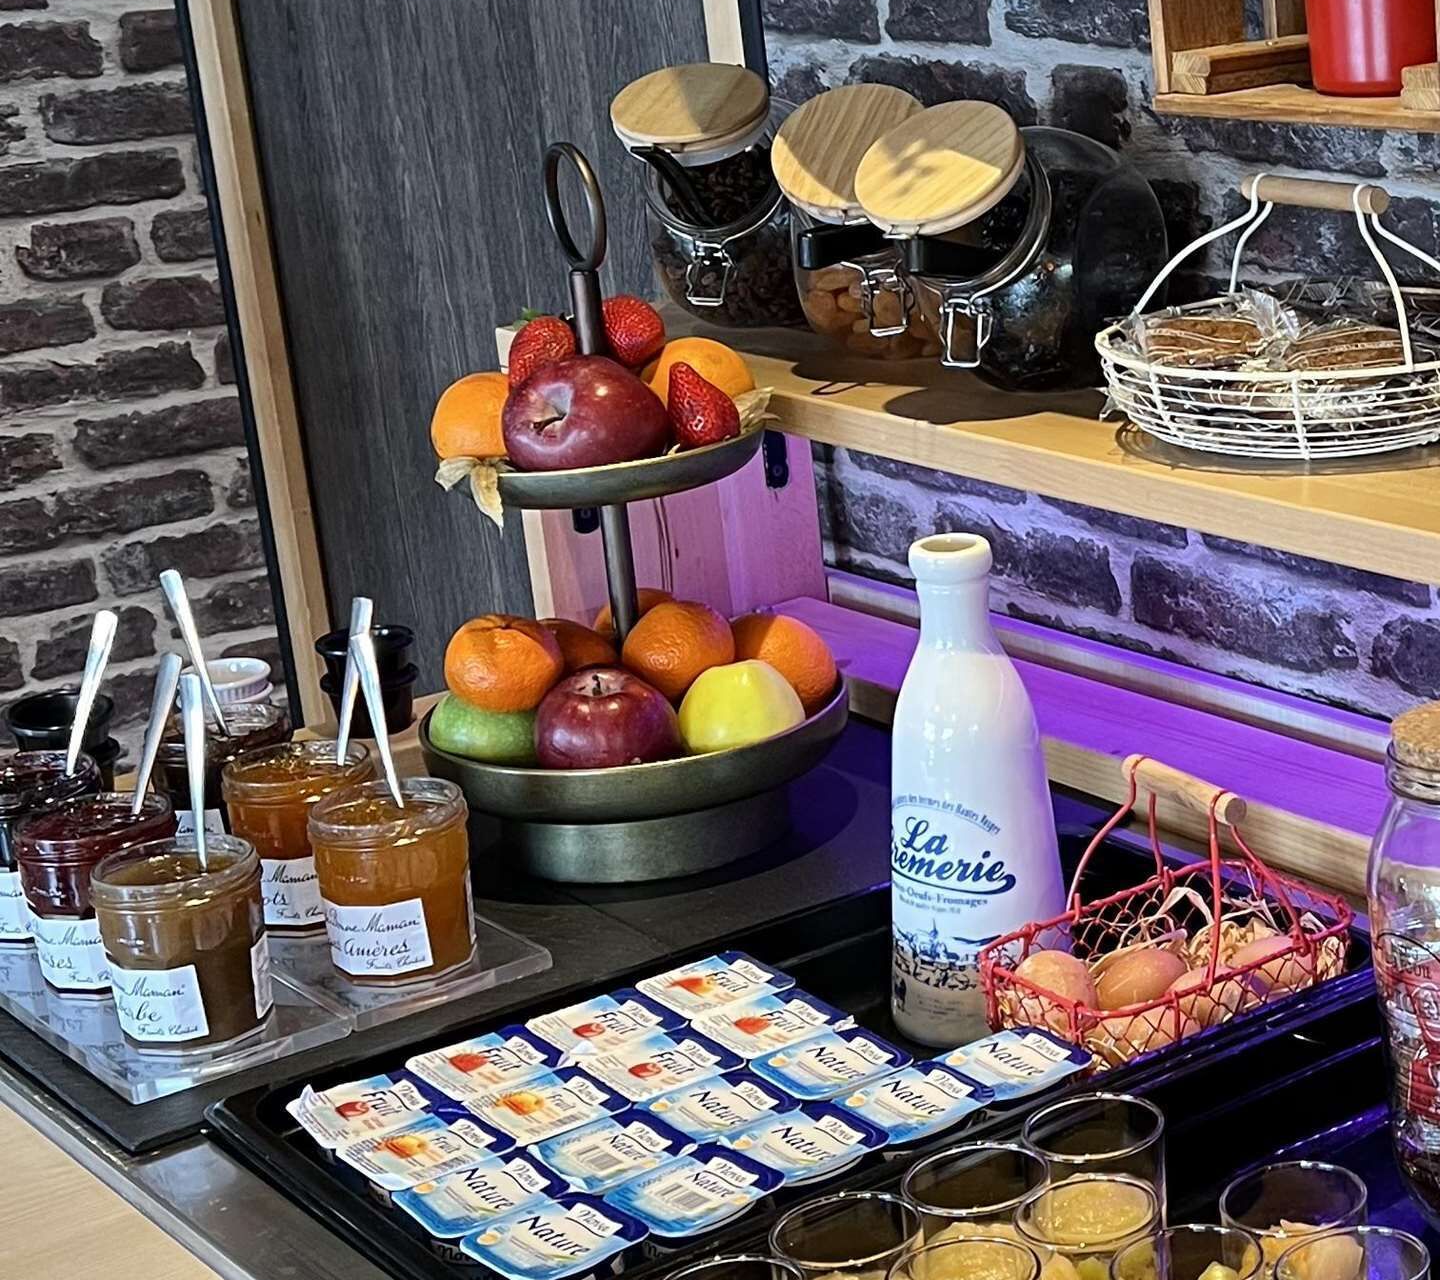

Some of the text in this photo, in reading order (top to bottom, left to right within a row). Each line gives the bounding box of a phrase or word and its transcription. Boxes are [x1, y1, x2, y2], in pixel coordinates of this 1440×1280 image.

[900, 816, 948, 856] La
[893, 842, 1005, 882] remerie
[344, 938, 411, 957] Amères
[705, 971, 749, 992] Fruit
[594, 1012, 638, 1034] Fruit
[760, 1010, 805, 1032] Fruit
[478, 1048, 521, 1072] Fruit
[650, 1052, 695, 1074] Fruit
[805, 1047, 866, 1079] Nature
[979, 1041, 1045, 1075] Nature
[361, 1090, 402, 1117] Fruit
[689, 1089, 749, 1126] Nature
[882, 1079, 946, 1115] Nature
[602, 1134, 647, 1160] Nature
[771, 1127, 836, 1161] Nature
[455, 1167, 515, 1209] Nature
[684, 1172, 735, 1198] Nature
[517, 1216, 591, 1255] Nature
